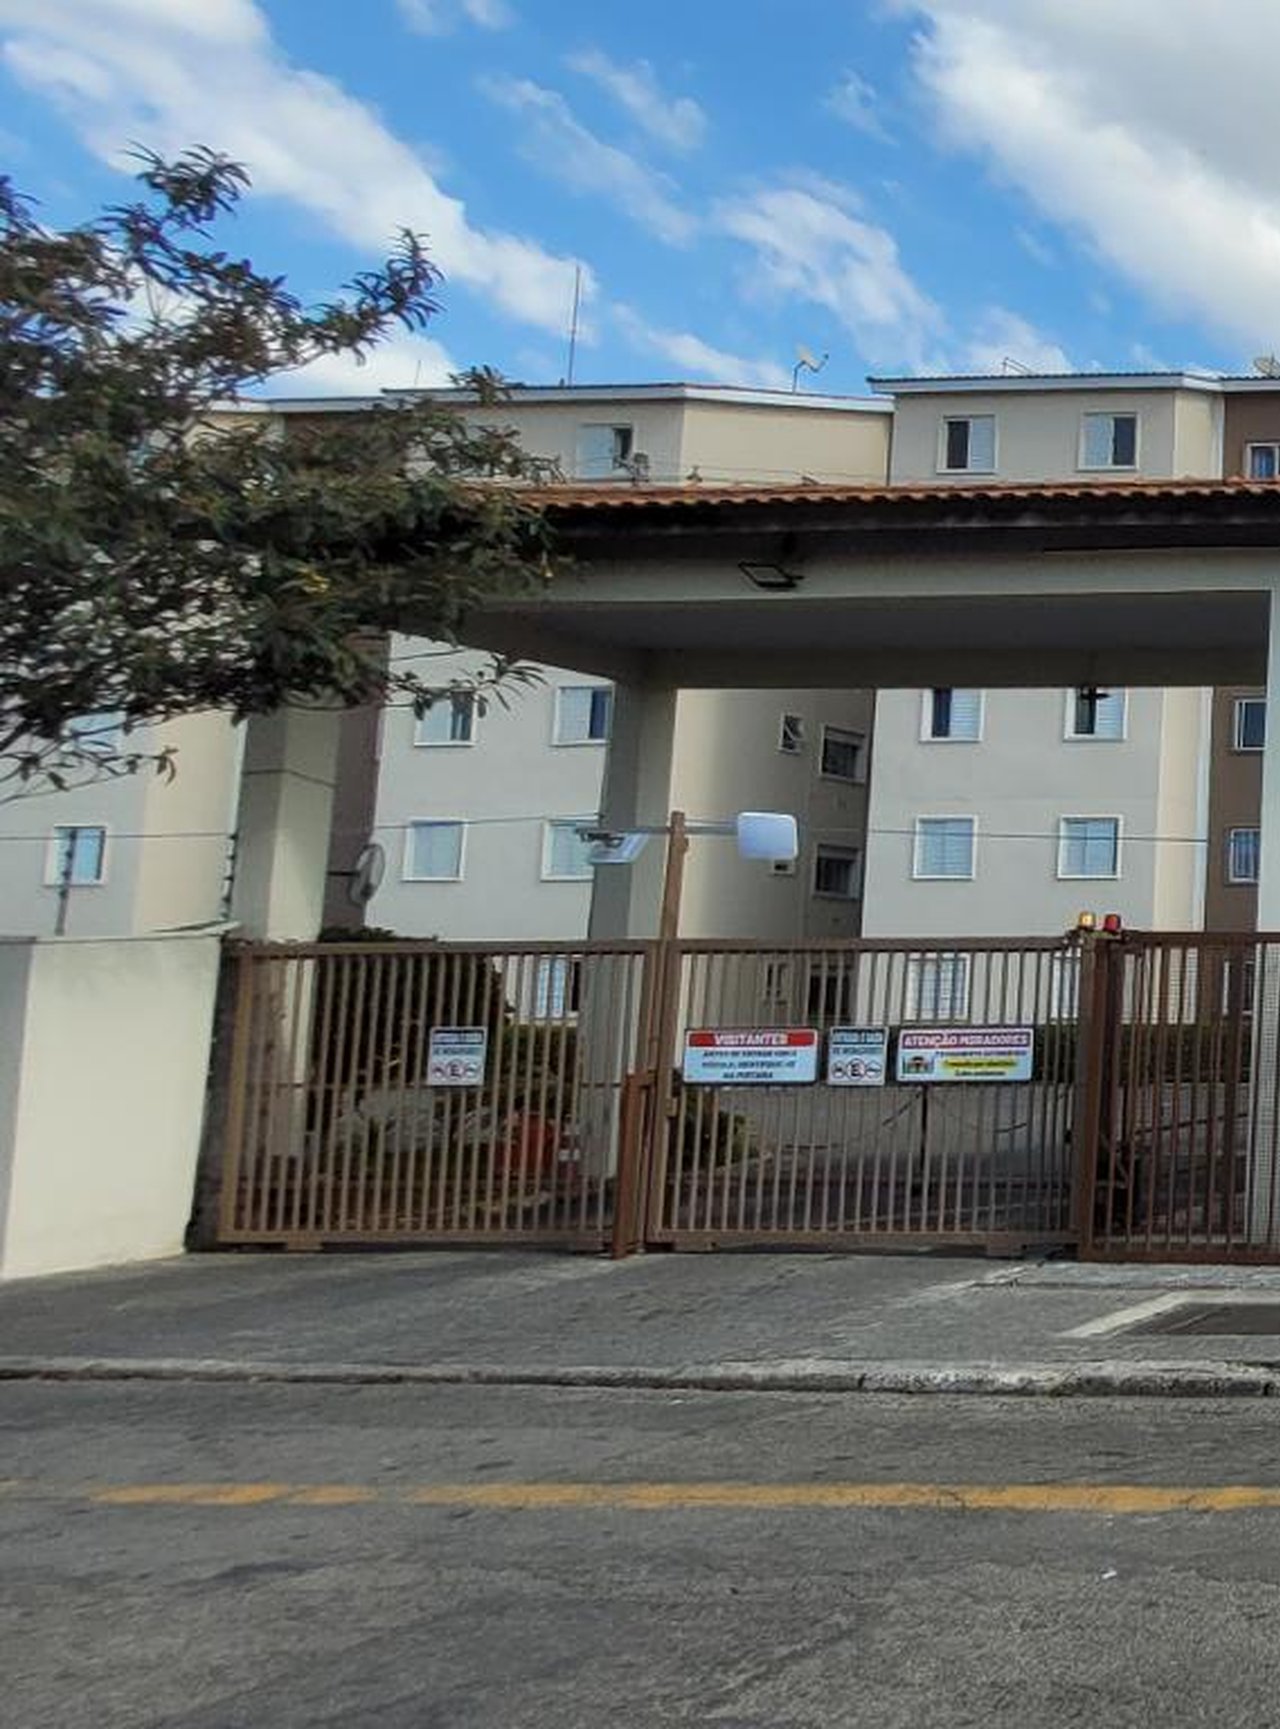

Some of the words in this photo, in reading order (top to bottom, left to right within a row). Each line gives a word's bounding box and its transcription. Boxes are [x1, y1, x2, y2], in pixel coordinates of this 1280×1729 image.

[714, 1033, 788, 1046] VISITANTES
[904, 1032, 957, 1047] ATENÇÃO
[960, 1034, 1027, 1046] MORADORES
